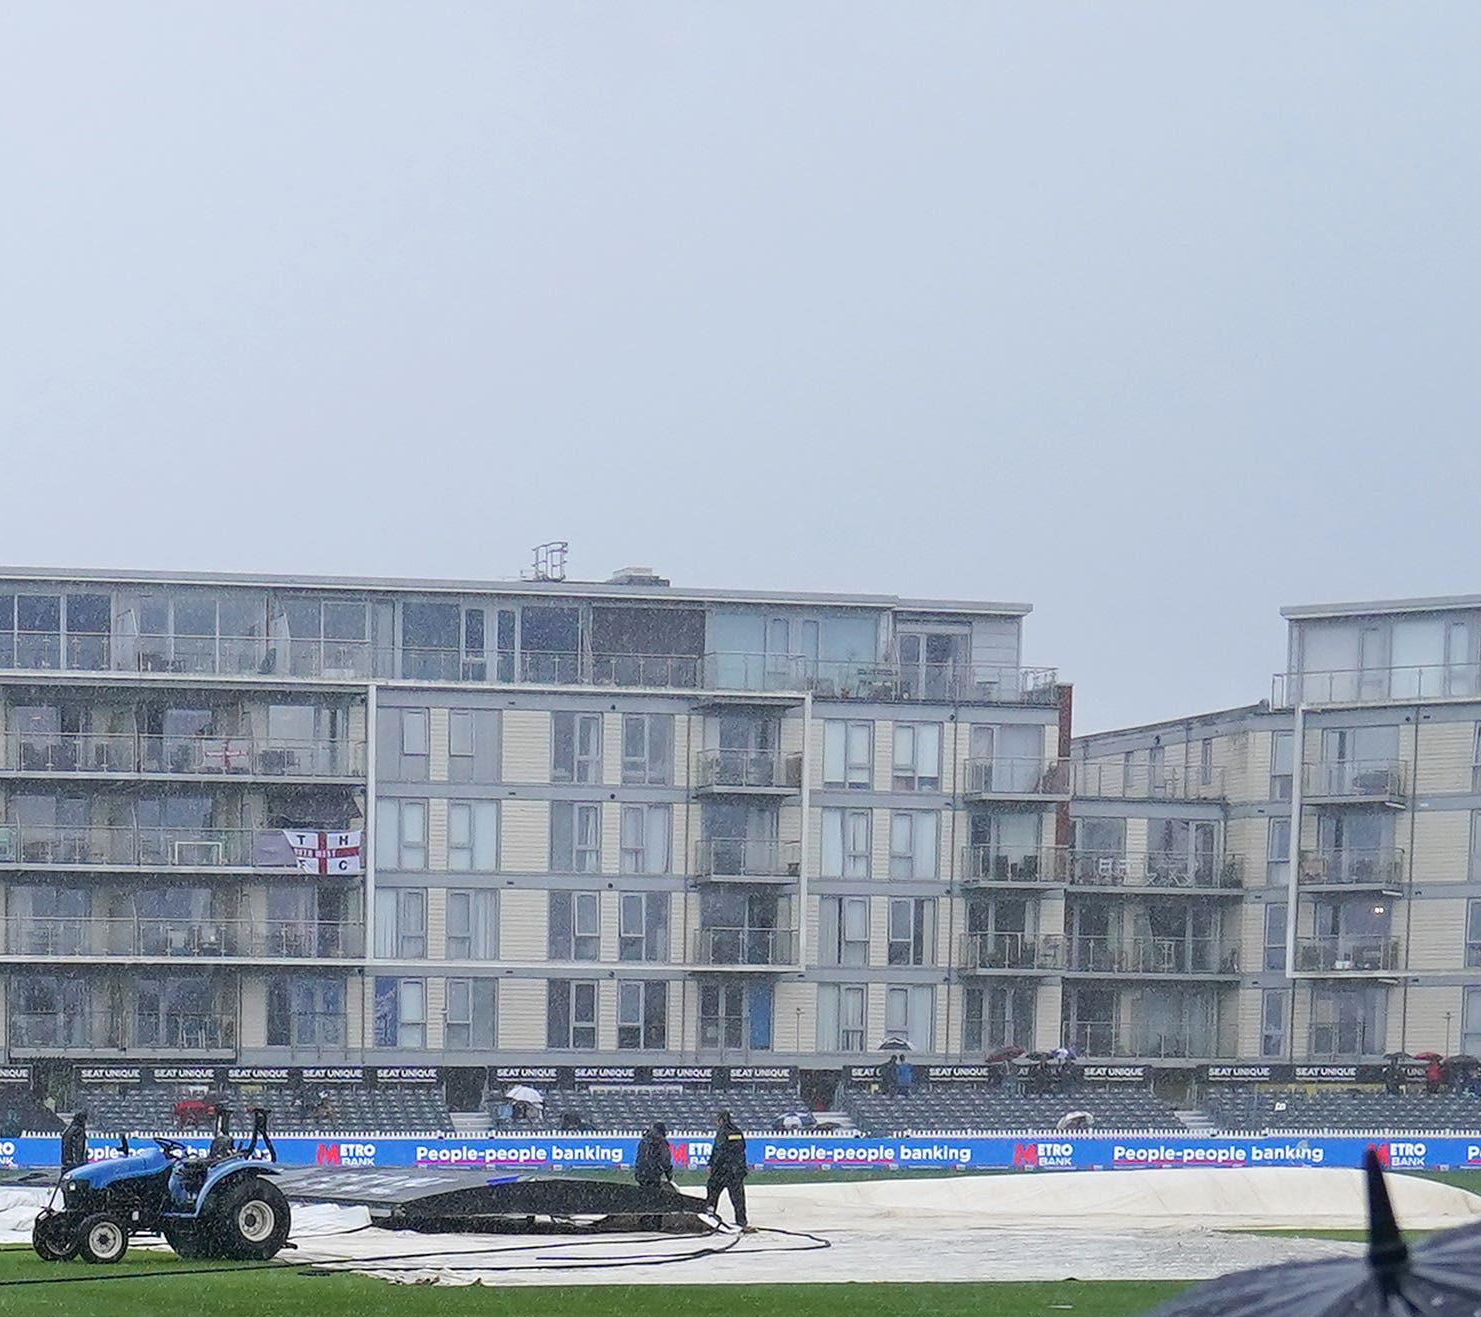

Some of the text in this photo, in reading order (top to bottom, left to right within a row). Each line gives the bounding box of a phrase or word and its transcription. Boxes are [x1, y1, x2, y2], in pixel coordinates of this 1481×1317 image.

[81, 1069, 140, 1079] SEAT UNIQUE
[154, 1069, 214, 1079] SEAT UNIQUE
[228, 1069, 288, 1079] SEAT UNIQUE
[303, 1069, 363, 1079] SEAT UNIQUE
[377, 1069, 437, 1079] SEAT UNIQUE
[497, 1069, 557, 1078] SEAT UNIQUE
[574, 1069, 634, 1078] SEAT UNIQUE
[652, 1069, 712, 1078] SEAT UNIQUE
[730, 1069, 790, 1078] SEAT UNIQUE
[851, 1069, 875, 1078] SEAT
[929, 1068, 988, 1077] SEAT UNIQUE
[1084, 1068, 1143, 1077] SEAT UNIQUE
[1209, 1068, 1270, 1077] SEAT UNIQUE
[1296, 1068, 1356, 1077] SEAT UNIQUE
[317, 1143, 375, 1166] METRO
[416, 1145, 623, 1164] People-people banking
[668, 1143, 712, 1164] METR
[765, 1143, 971, 1164] People-people banking
[1015, 1143, 1073, 1166] METRO
[1113, 1146, 1324, 1164] People-people banking
[342, 1157, 375, 1166] BANK
[1039, 1155, 1072, 1166] BANK
[1391, 1157, 1425, 1166] BANK
